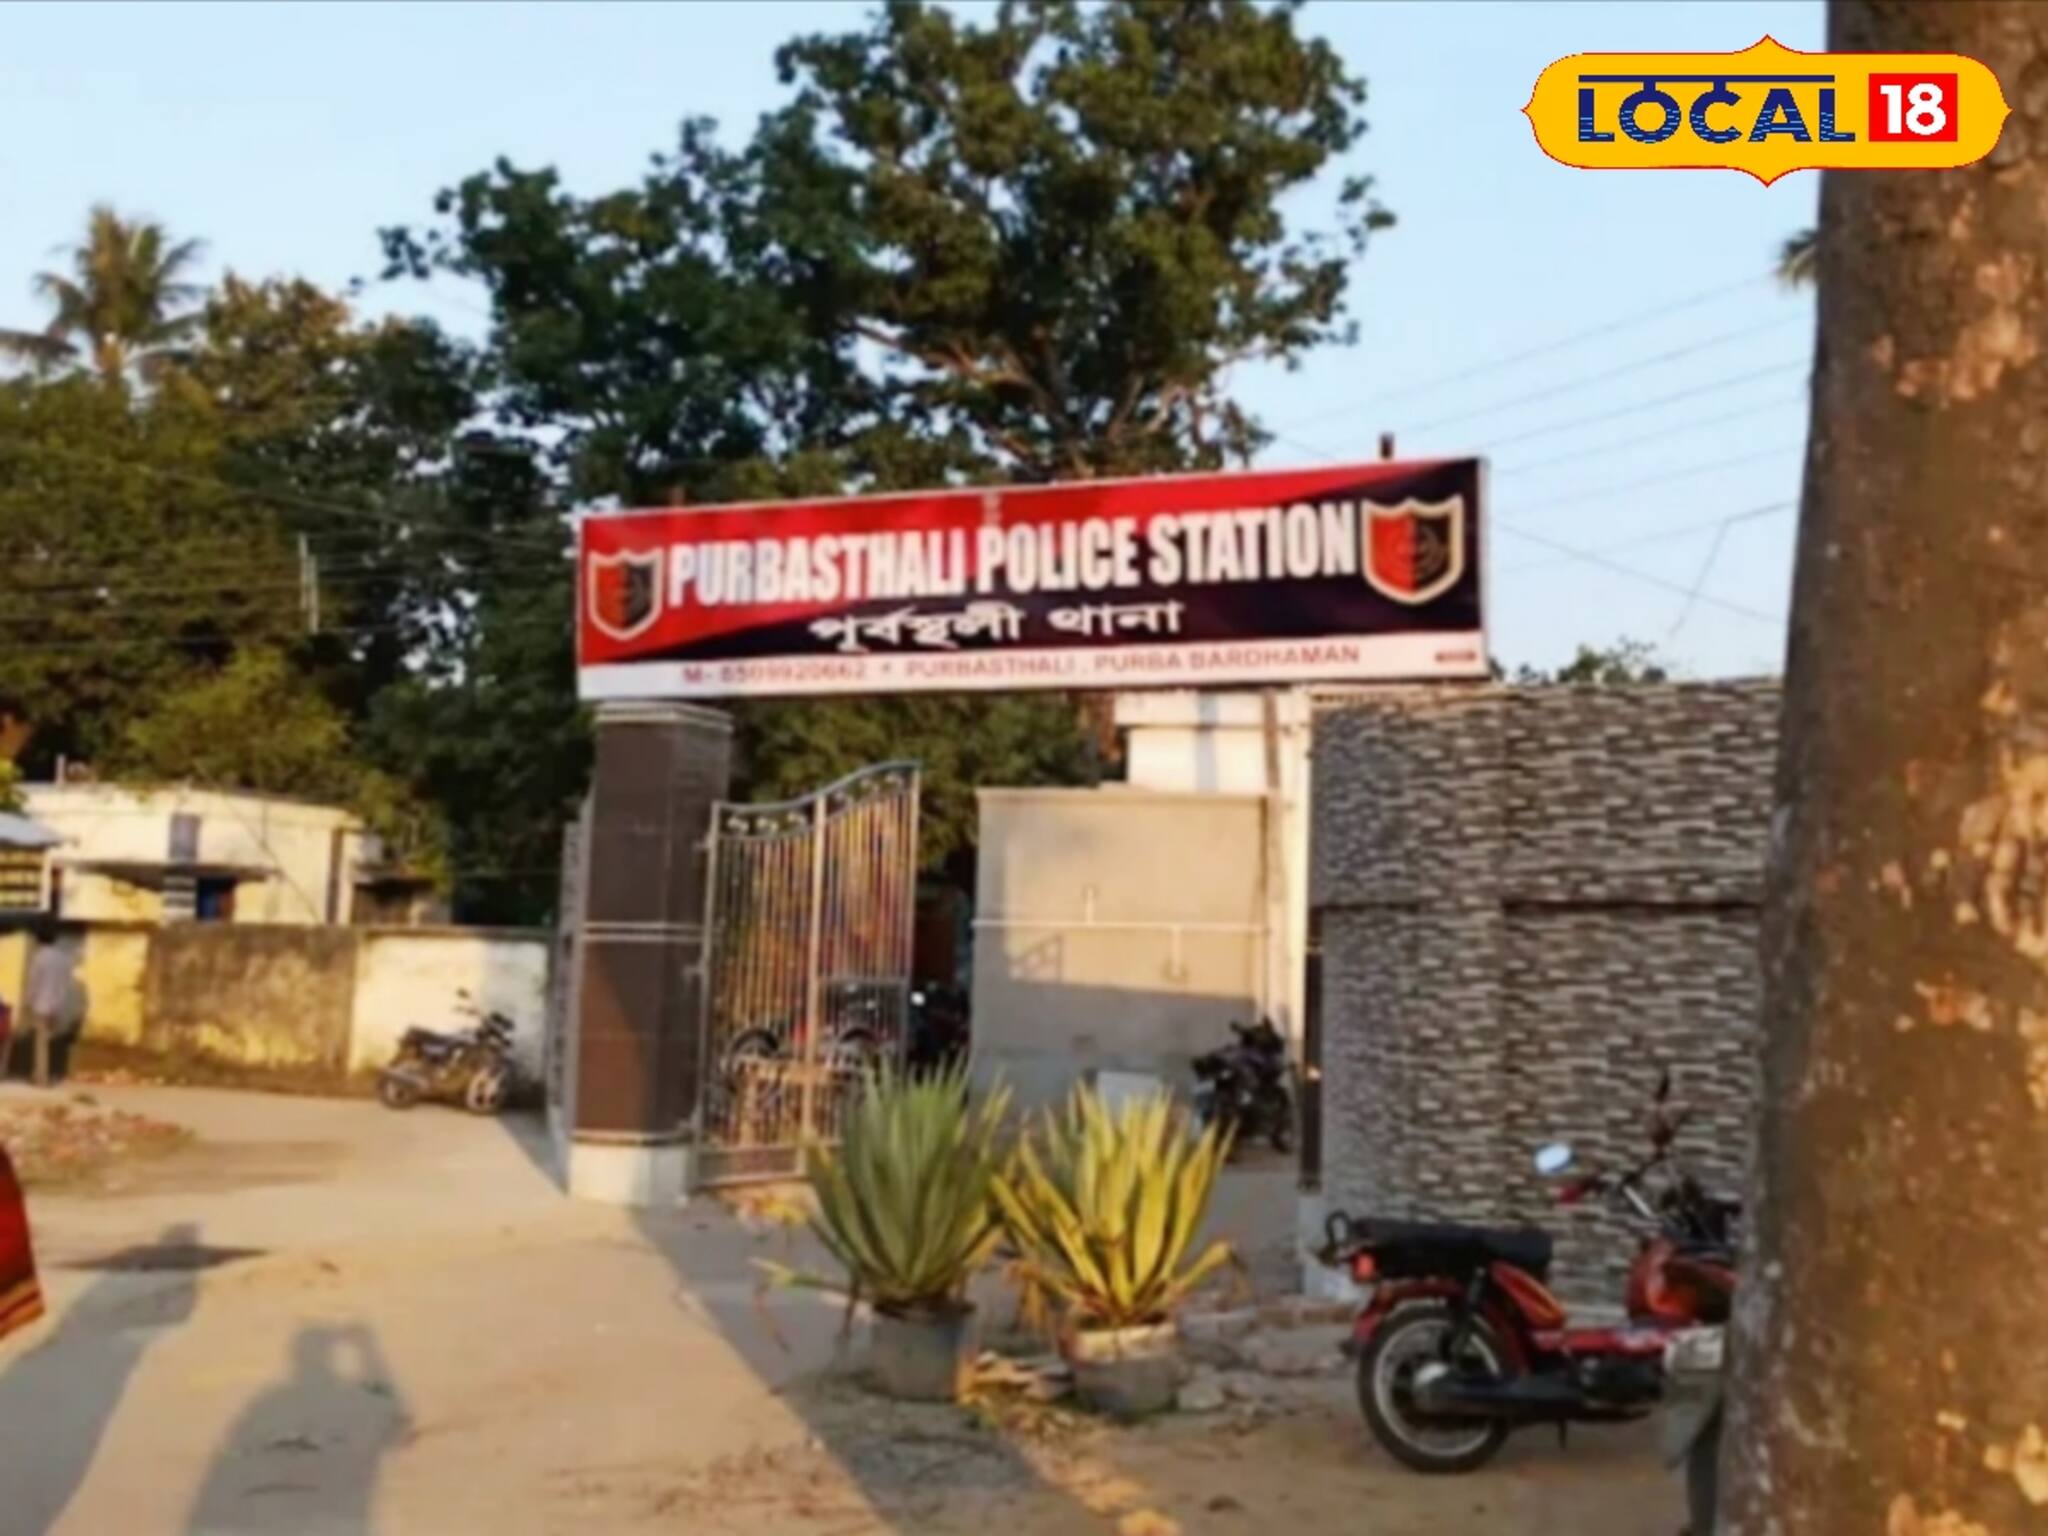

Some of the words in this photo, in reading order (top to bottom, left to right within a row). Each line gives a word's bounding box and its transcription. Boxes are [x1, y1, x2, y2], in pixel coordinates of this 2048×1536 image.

[668, 528, 966, 607] PURBASTHALI
[976, 514, 1140, 593] POLICE
[1148, 501, 1358, 585] STATION
[1047, 600, 1185, 636] থানা
[1094, 651, 1183, 670] PURBA
[1189, 644, 1360, 670] BARDHAMAN
